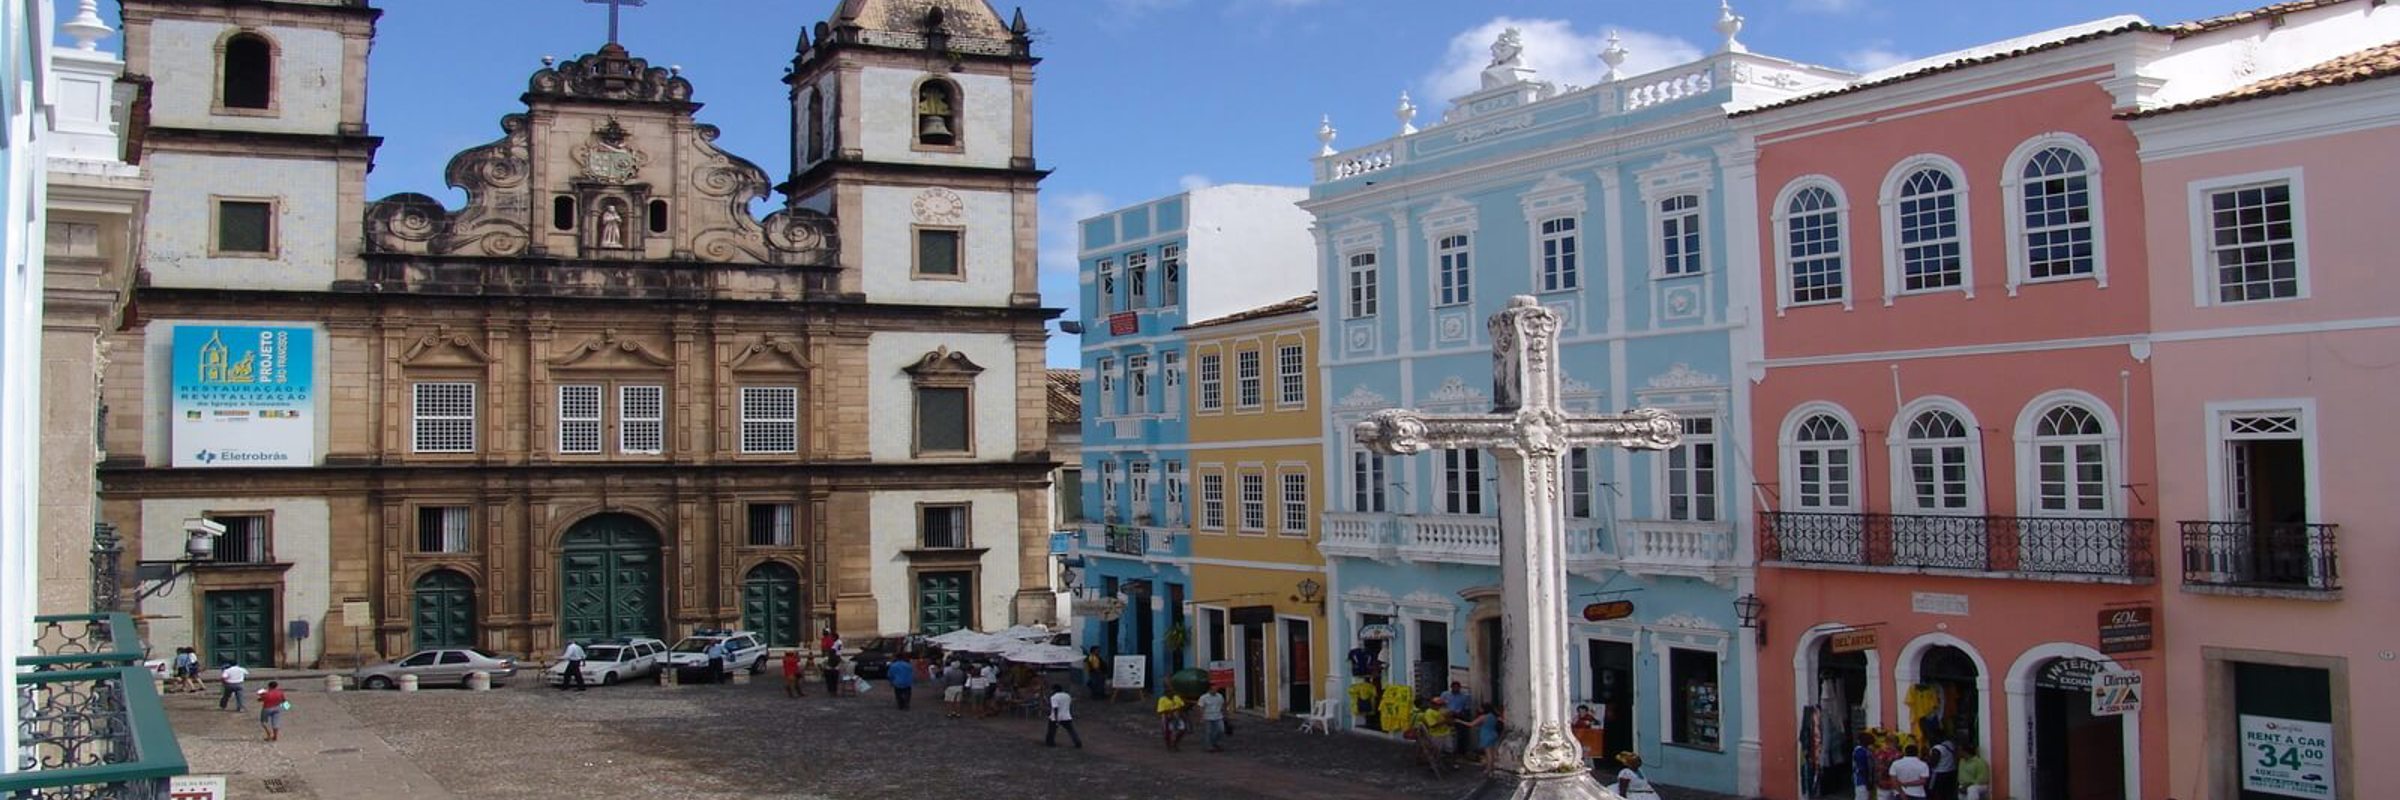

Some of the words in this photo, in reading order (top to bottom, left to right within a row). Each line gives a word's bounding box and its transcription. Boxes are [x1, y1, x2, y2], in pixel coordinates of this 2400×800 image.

[278, 331, 288, 367] FRANCISCO
[260, 331, 273, 383] PROJETO
[181, 385, 294, 393] RESTAURAÇÃO
[181, 393, 307, 401] REVITALIZAÇÃO
[221, 451, 288, 461] Eletrobrás
[2112, 611, 2139, 624] GOL
[2047, 660, 2102, 680] INTERN
[2247, 731, 2281, 742] RENT
[2285, 735, 2294, 744] A
[2298, 736, 2326, 747] CAR
